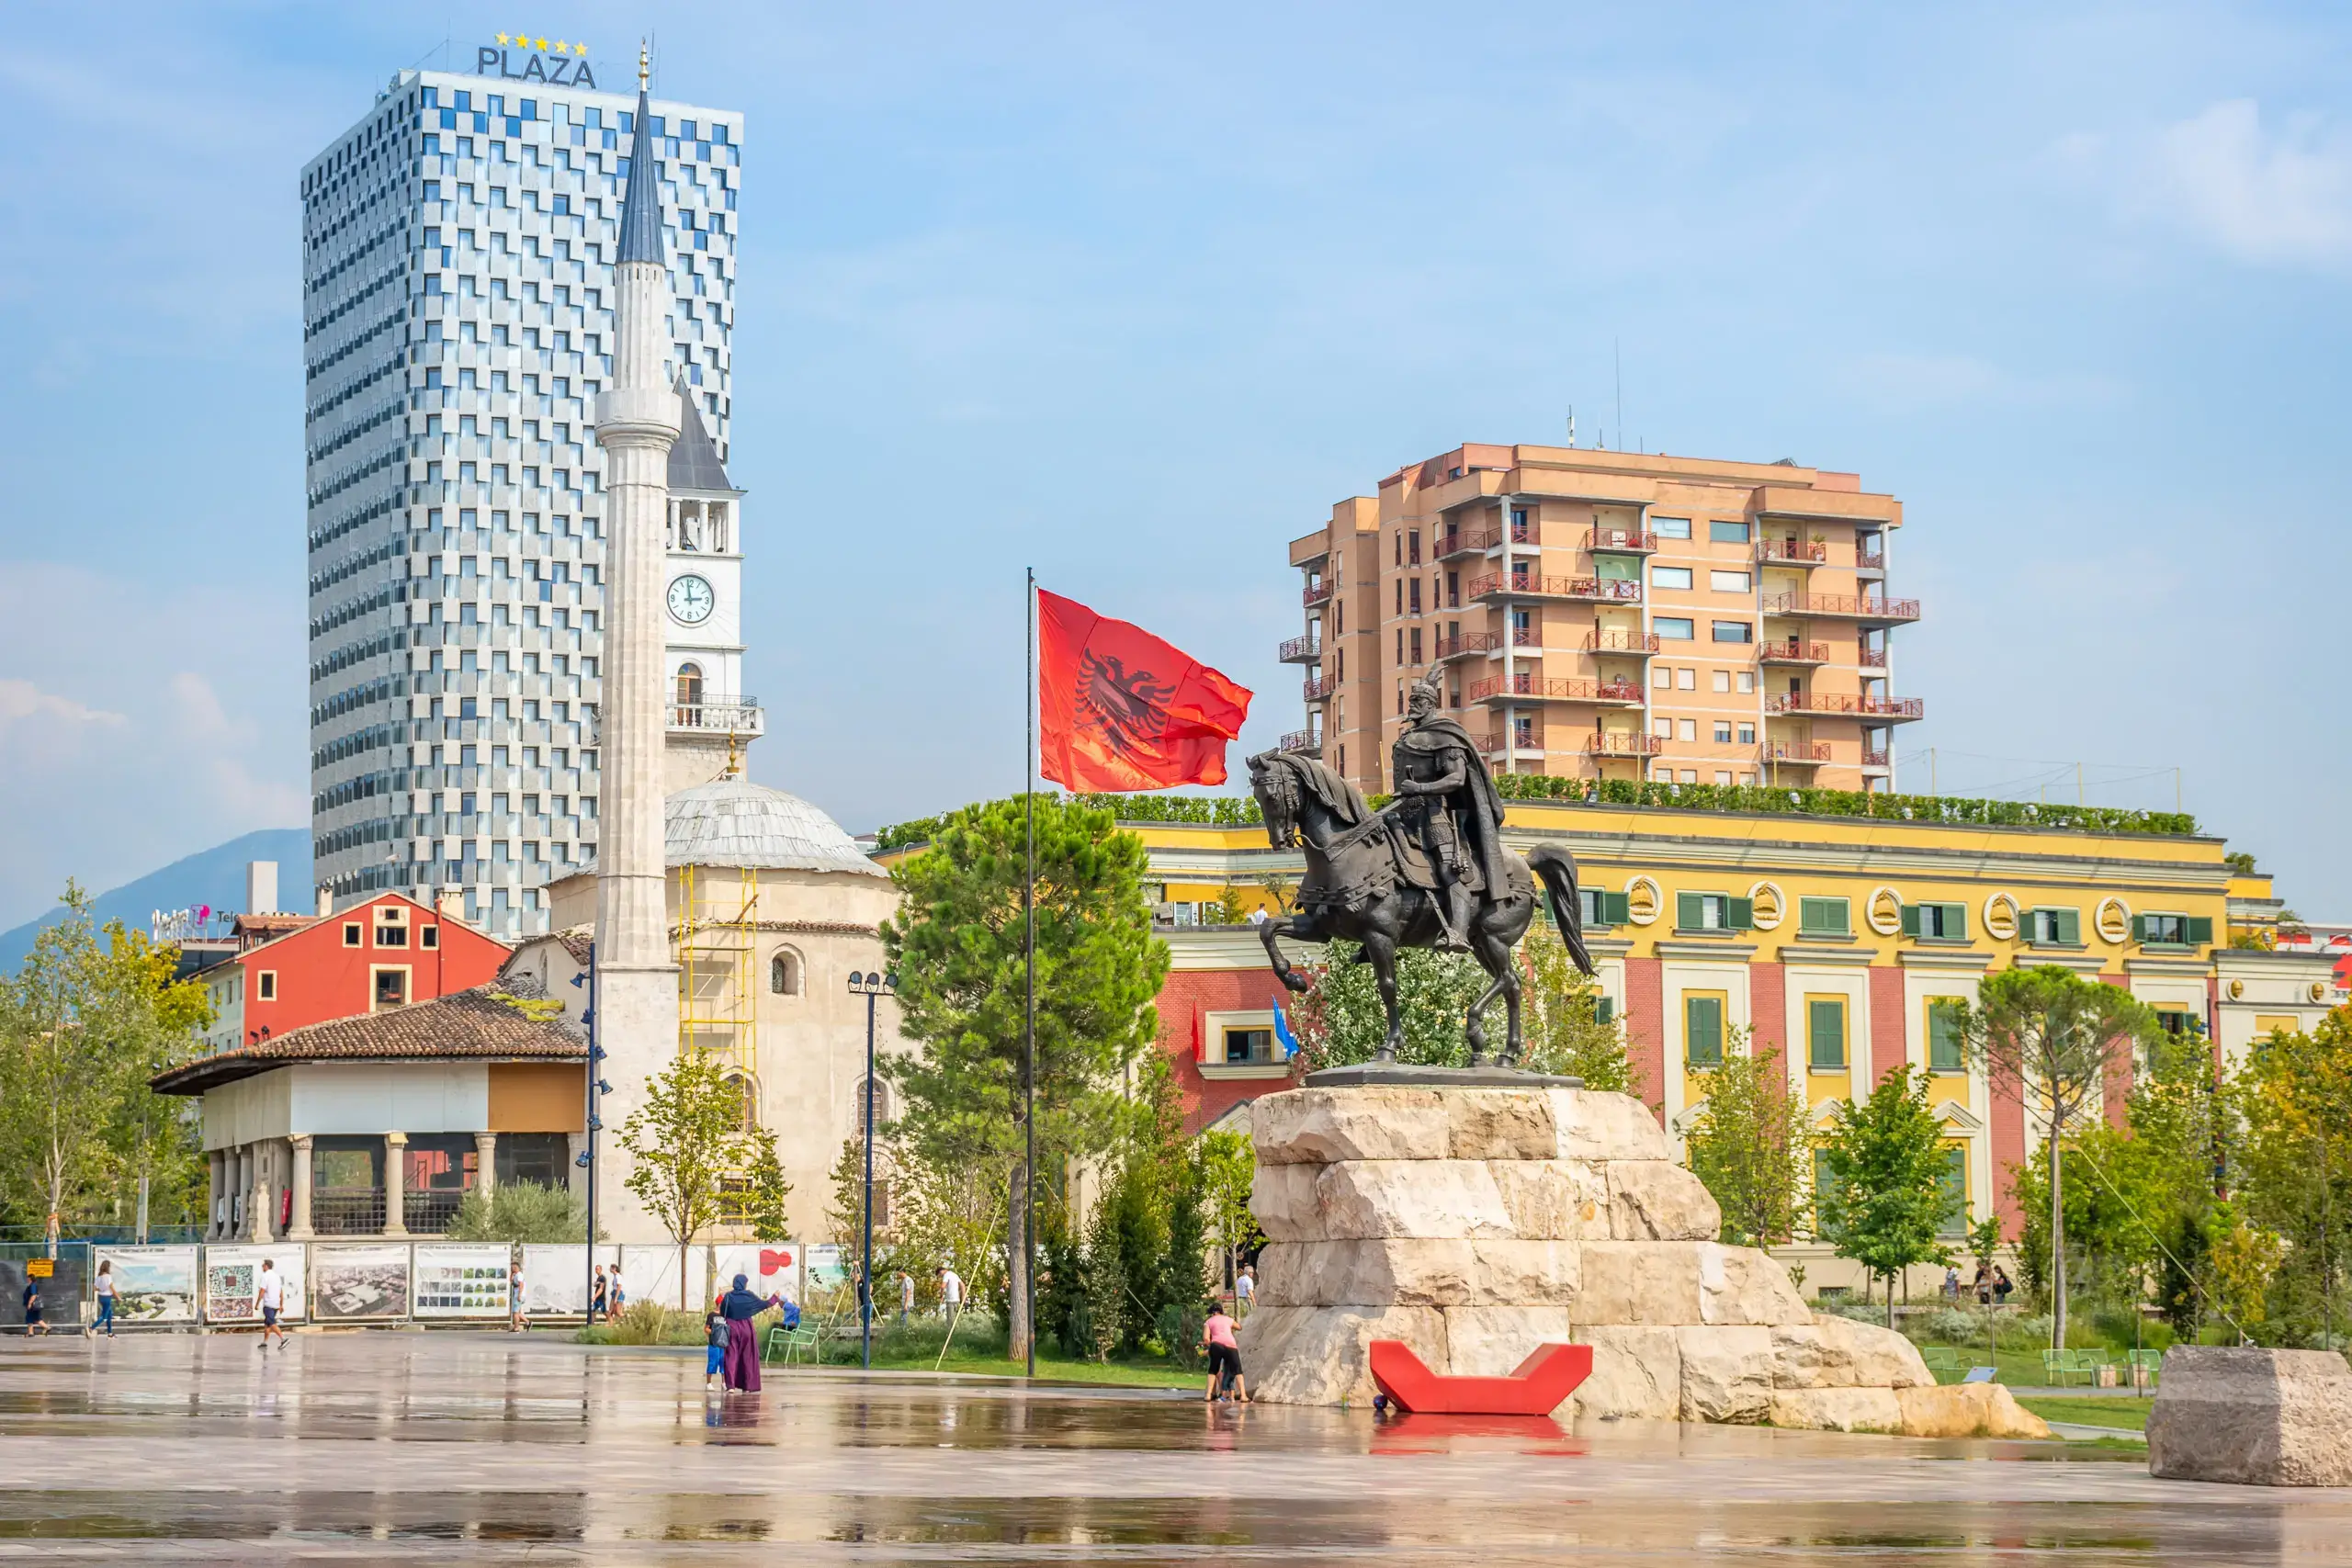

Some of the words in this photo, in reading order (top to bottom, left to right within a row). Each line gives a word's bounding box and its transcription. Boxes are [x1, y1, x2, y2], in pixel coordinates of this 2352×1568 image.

[478, 47, 596, 89] PLAZA
[670, 594, 675, 603] 9
[705, 596, 709, 604] 3
[687, 611, 692, 620] 6
